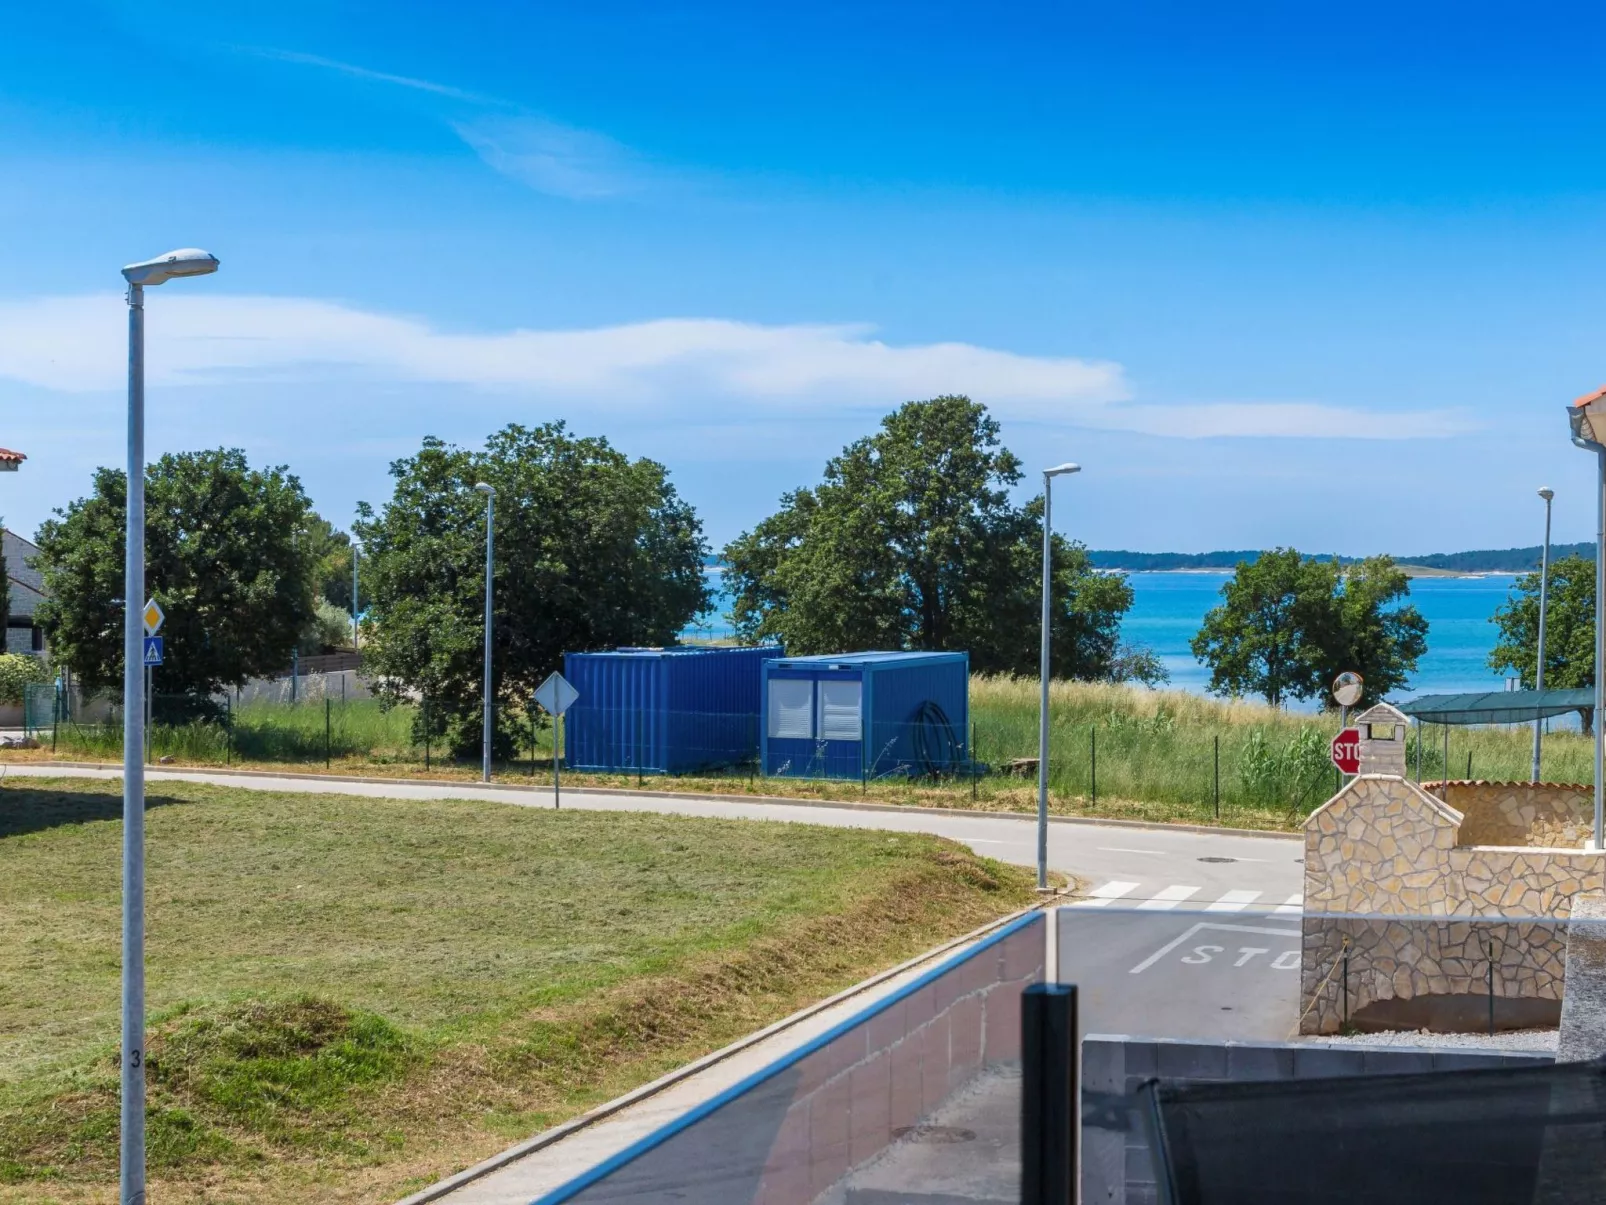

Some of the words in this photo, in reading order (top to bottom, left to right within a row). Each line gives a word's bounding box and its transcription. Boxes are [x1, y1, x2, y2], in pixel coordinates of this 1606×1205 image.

[1334, 742, 1360, 760] STO
[1180, 945, 1302, 970] STO
[131, 1049, 141, 1068] 3
